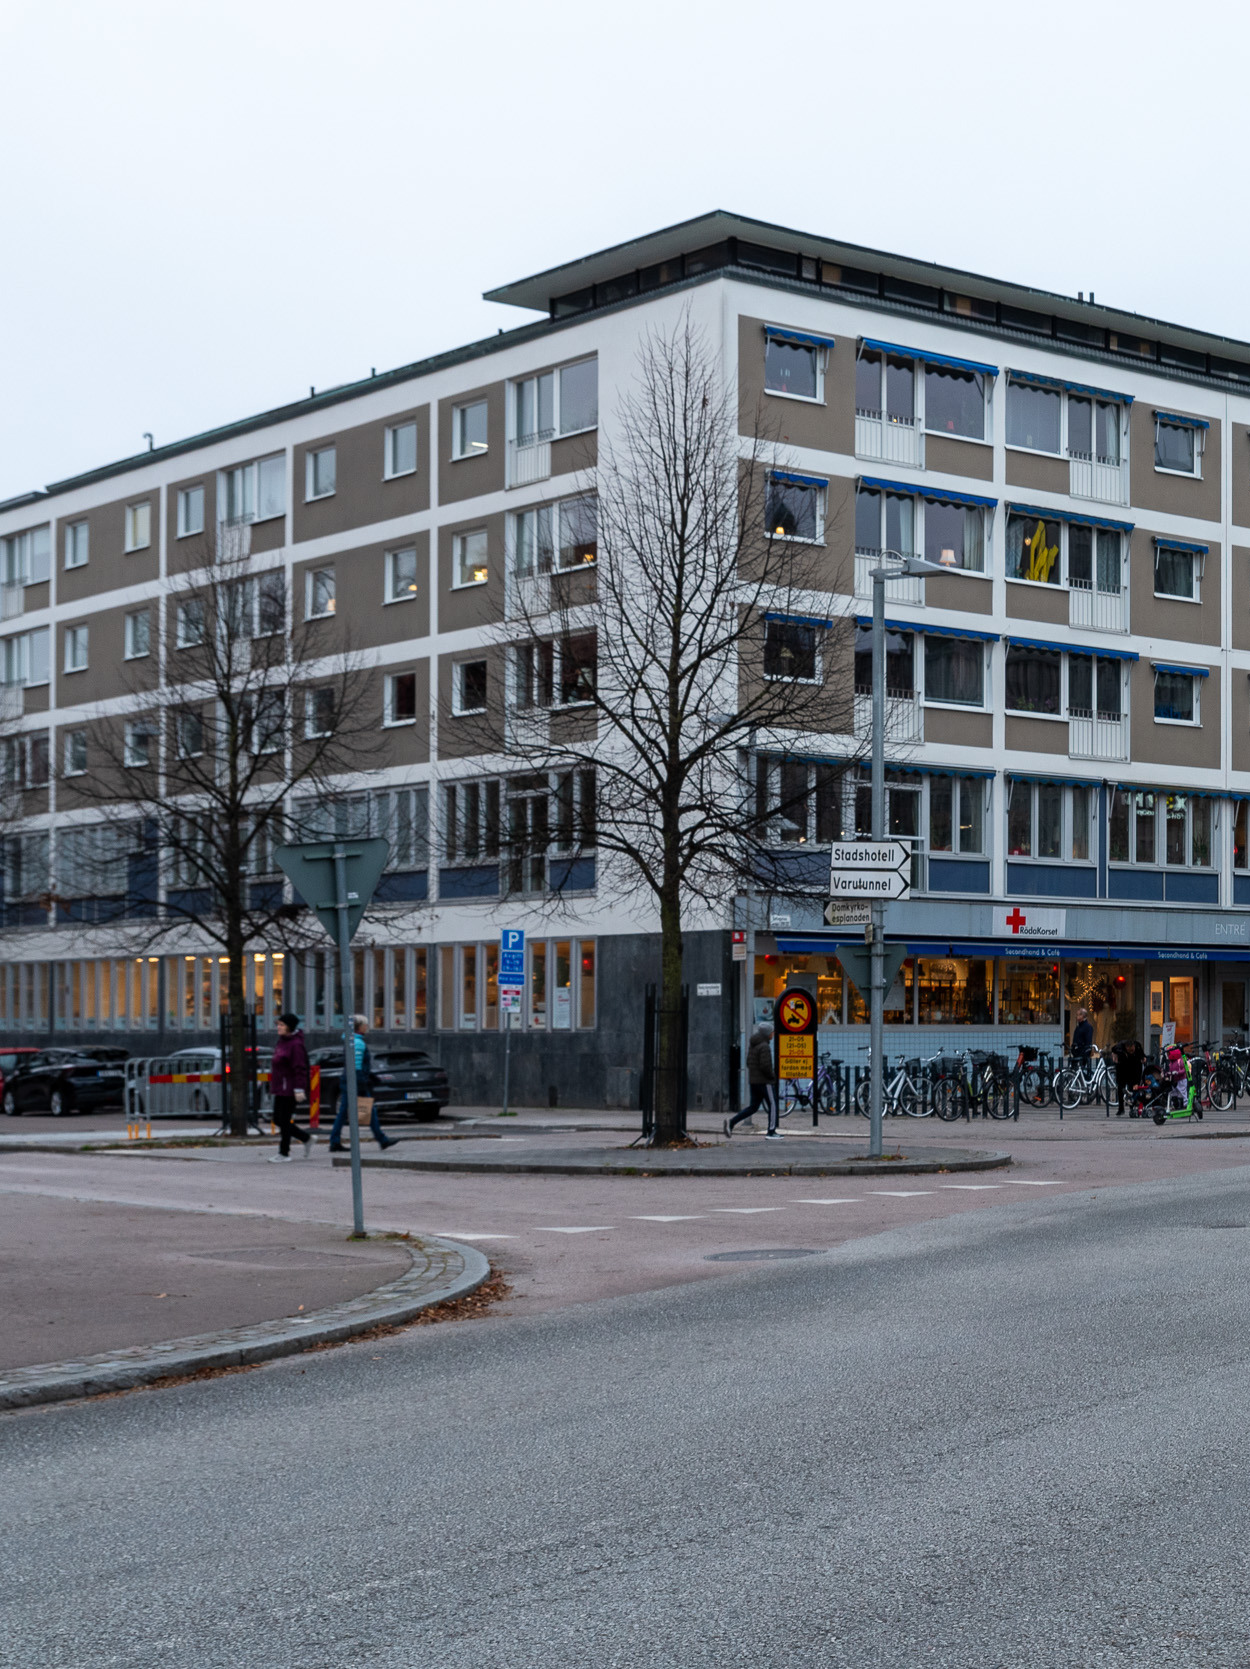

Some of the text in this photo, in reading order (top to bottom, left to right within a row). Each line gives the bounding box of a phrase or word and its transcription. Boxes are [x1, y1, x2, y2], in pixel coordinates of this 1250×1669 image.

[834, 848, 895, 862] Stadshotell
[833, 876, 892, 891] Varutunnel
[831, 902, 869, 912] Domkyrko-
[831, 912, 870, 923] esplanaden
[1215, 921, 1246, 936] ENTRÉ
[508, 931, 520, 949] P
[1004, 947, 1040, 956] Secondhand
[1041, 948, 1046, 956] &
[1157, 951, 1190, 959] Secondhand
